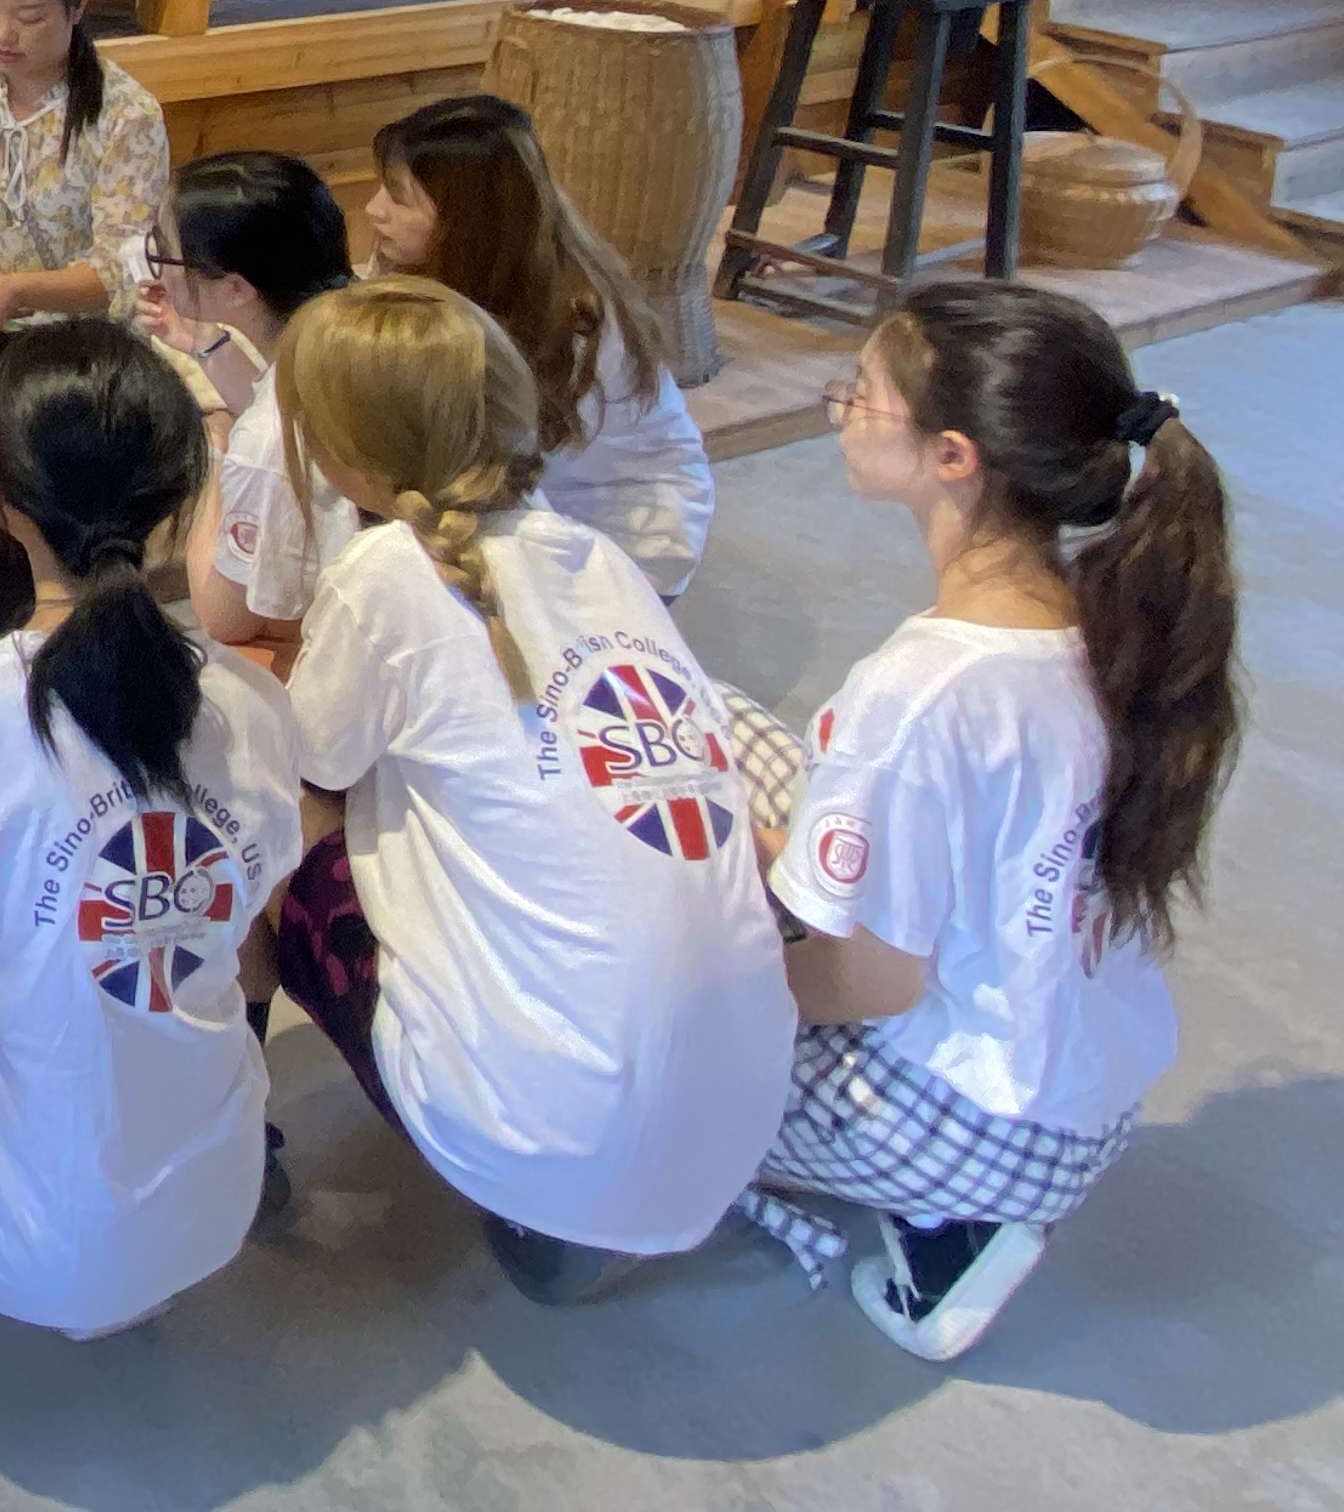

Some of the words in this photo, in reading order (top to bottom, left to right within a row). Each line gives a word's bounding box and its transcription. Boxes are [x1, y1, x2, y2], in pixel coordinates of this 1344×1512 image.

[536, 729, 562, 781] The
[47, 781, 133, 873] Sino-Brit
[193, 783, 242, 844] llege,
[35, 880, 60, 928] The
[1026, 888, 1054, 938] The
